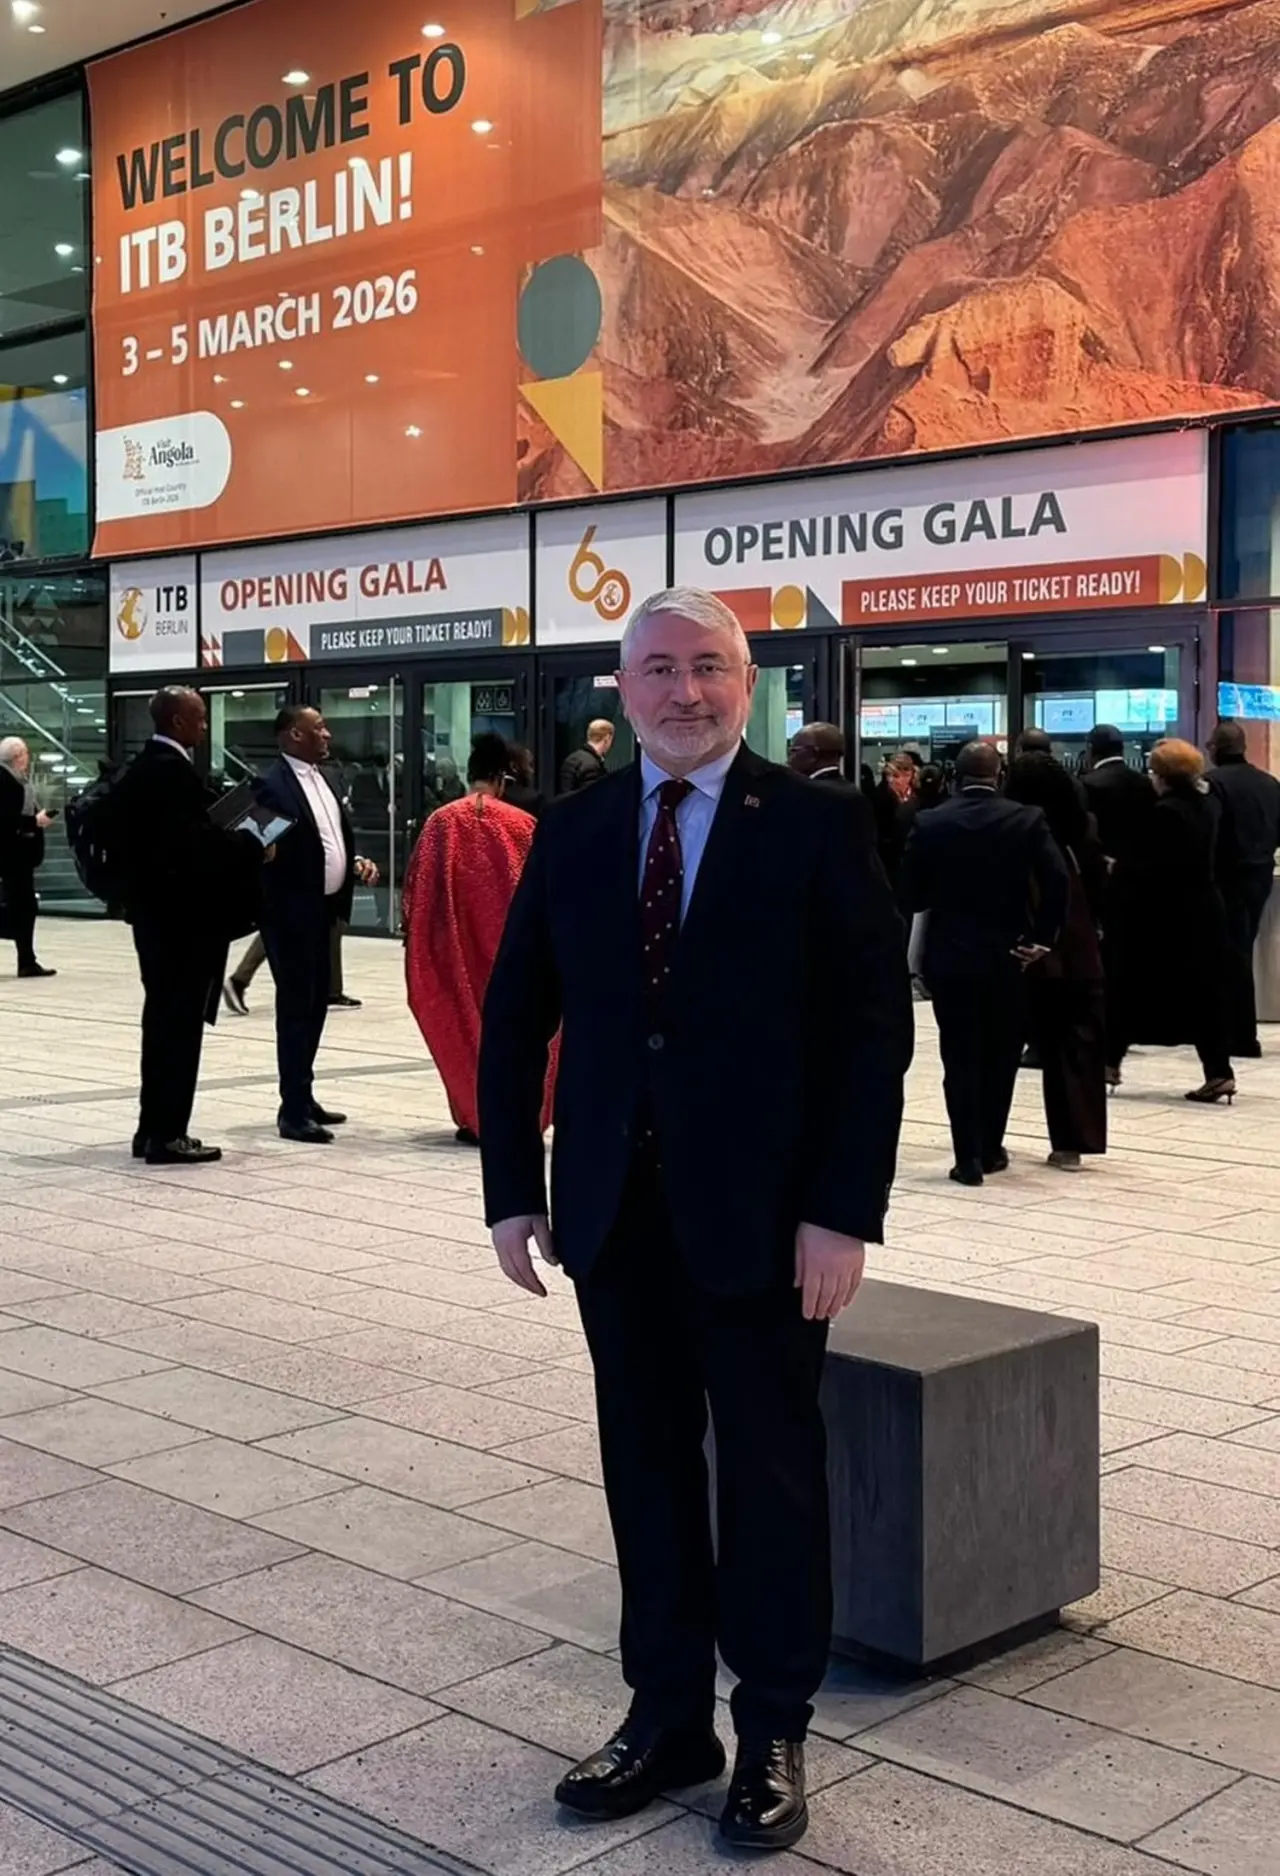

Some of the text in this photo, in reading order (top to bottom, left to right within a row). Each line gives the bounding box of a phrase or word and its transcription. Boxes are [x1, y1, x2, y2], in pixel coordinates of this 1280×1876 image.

[117, 43, 466, 210] WELCOME TO
[119, 151, 413, 294] ITB BERLIN!
[121, 336, 138, 376] 3
[171, 324, 188, 365] 5
[198, 293, 320, 358] MARCH
[332, 270, 418, 329] 2026
[147, 441, 194, 468] Angola
[704, 492, 1066, 565] OPENING GALA
[156, 585, 188, 613] ITB
[220, 558, 448, 612] OPENING GALA
[860, 571, 1141, 613] PLEASE KEEP YOUR TICKET READY!
[156, 619, 188, 636] BERLIN
[321, 619, 492, 650] PLEASE KEEP YOUR TICKET READY!
